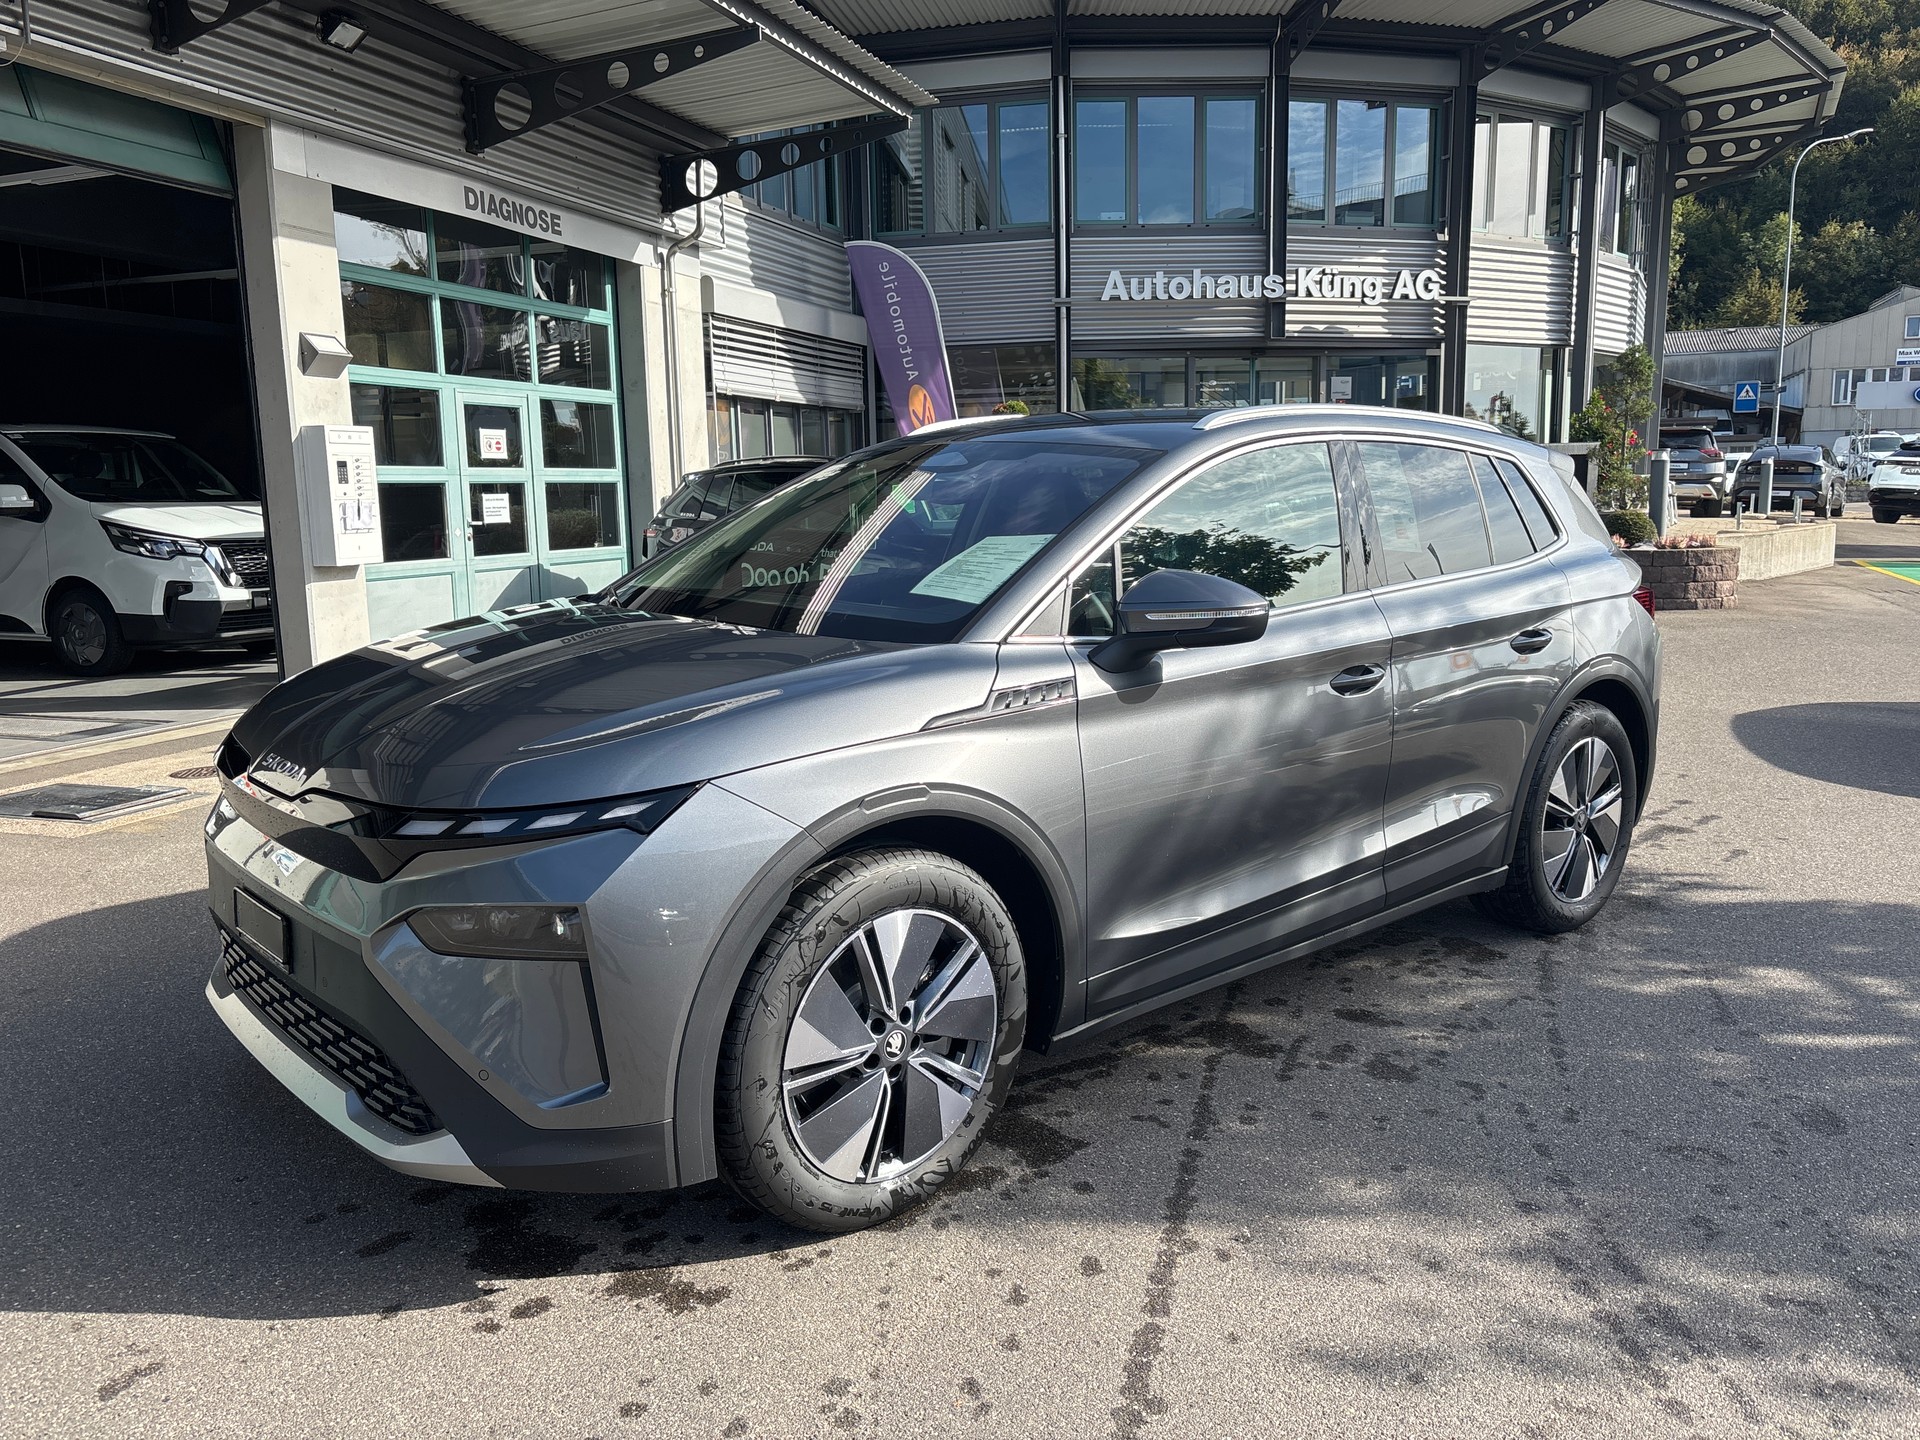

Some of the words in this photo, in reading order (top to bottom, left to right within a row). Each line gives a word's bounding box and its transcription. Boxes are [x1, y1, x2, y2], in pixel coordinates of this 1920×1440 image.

[463, 185, 562, 236] DIAGNOSE
[1100, 269, 1286, 301] Autohaus
[1297, 267, 1384, 305] Küng
[1391, 268, 1440, 301] AG
